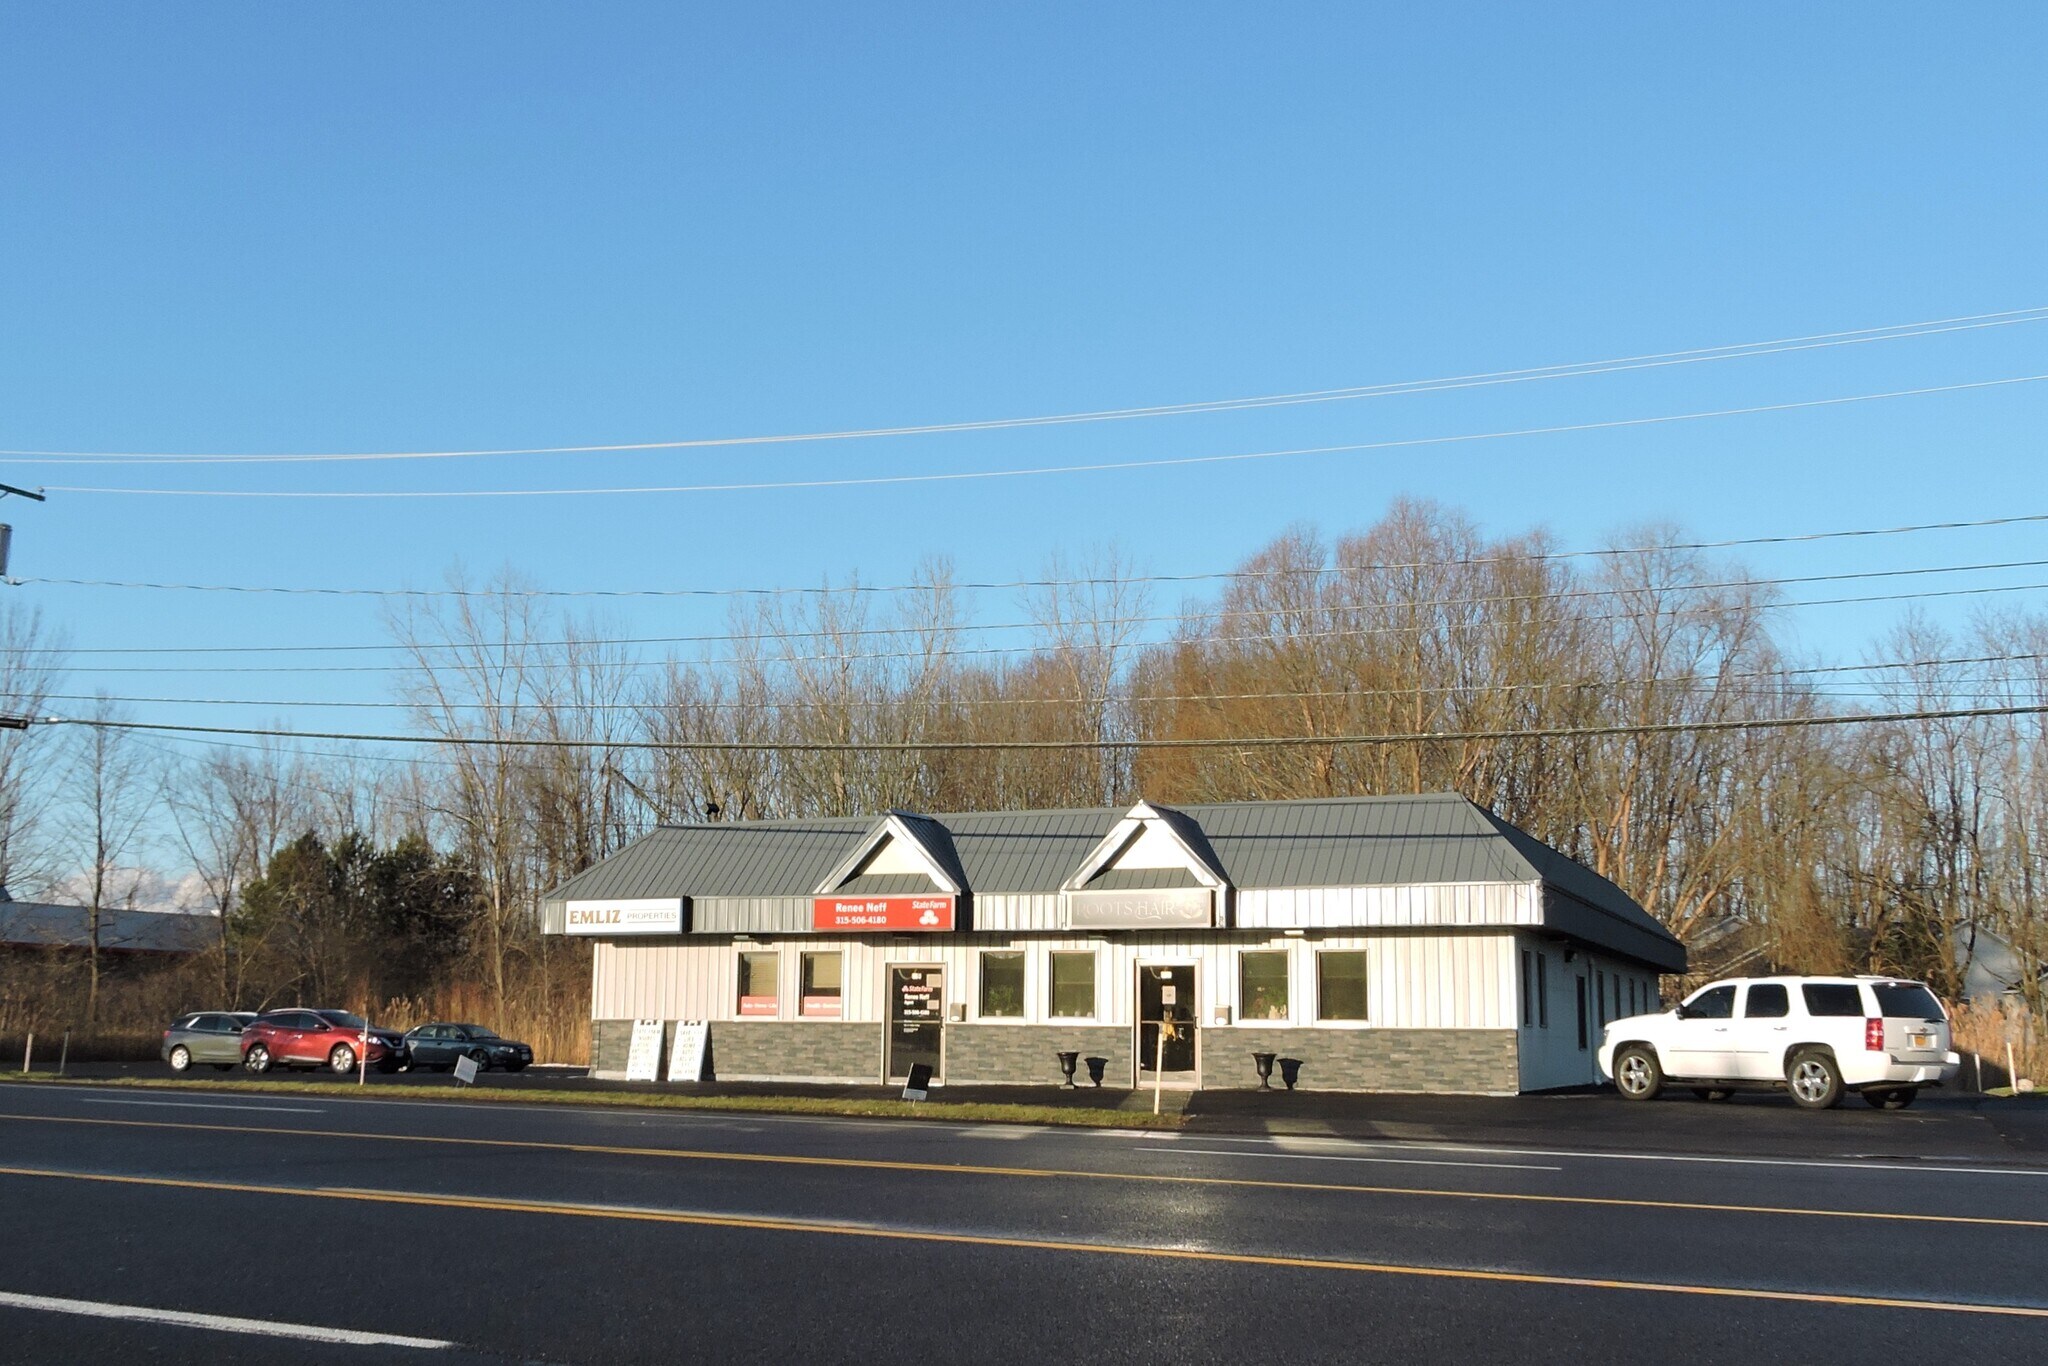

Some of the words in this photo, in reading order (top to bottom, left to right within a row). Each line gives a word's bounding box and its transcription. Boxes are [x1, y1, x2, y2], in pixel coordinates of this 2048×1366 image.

[835, 902, 864, 913] Renee
[866, 902, 887, 913] Neff
[1077, 901, 1133, 918] ROOTS
[1136, 900, 1176, 920] HAIR
[569, 910, 622, 924] EMLIZ
[627, 912, 677, 920] PROPERTIES
[835, 915, 887, 925] 315-506-4180
